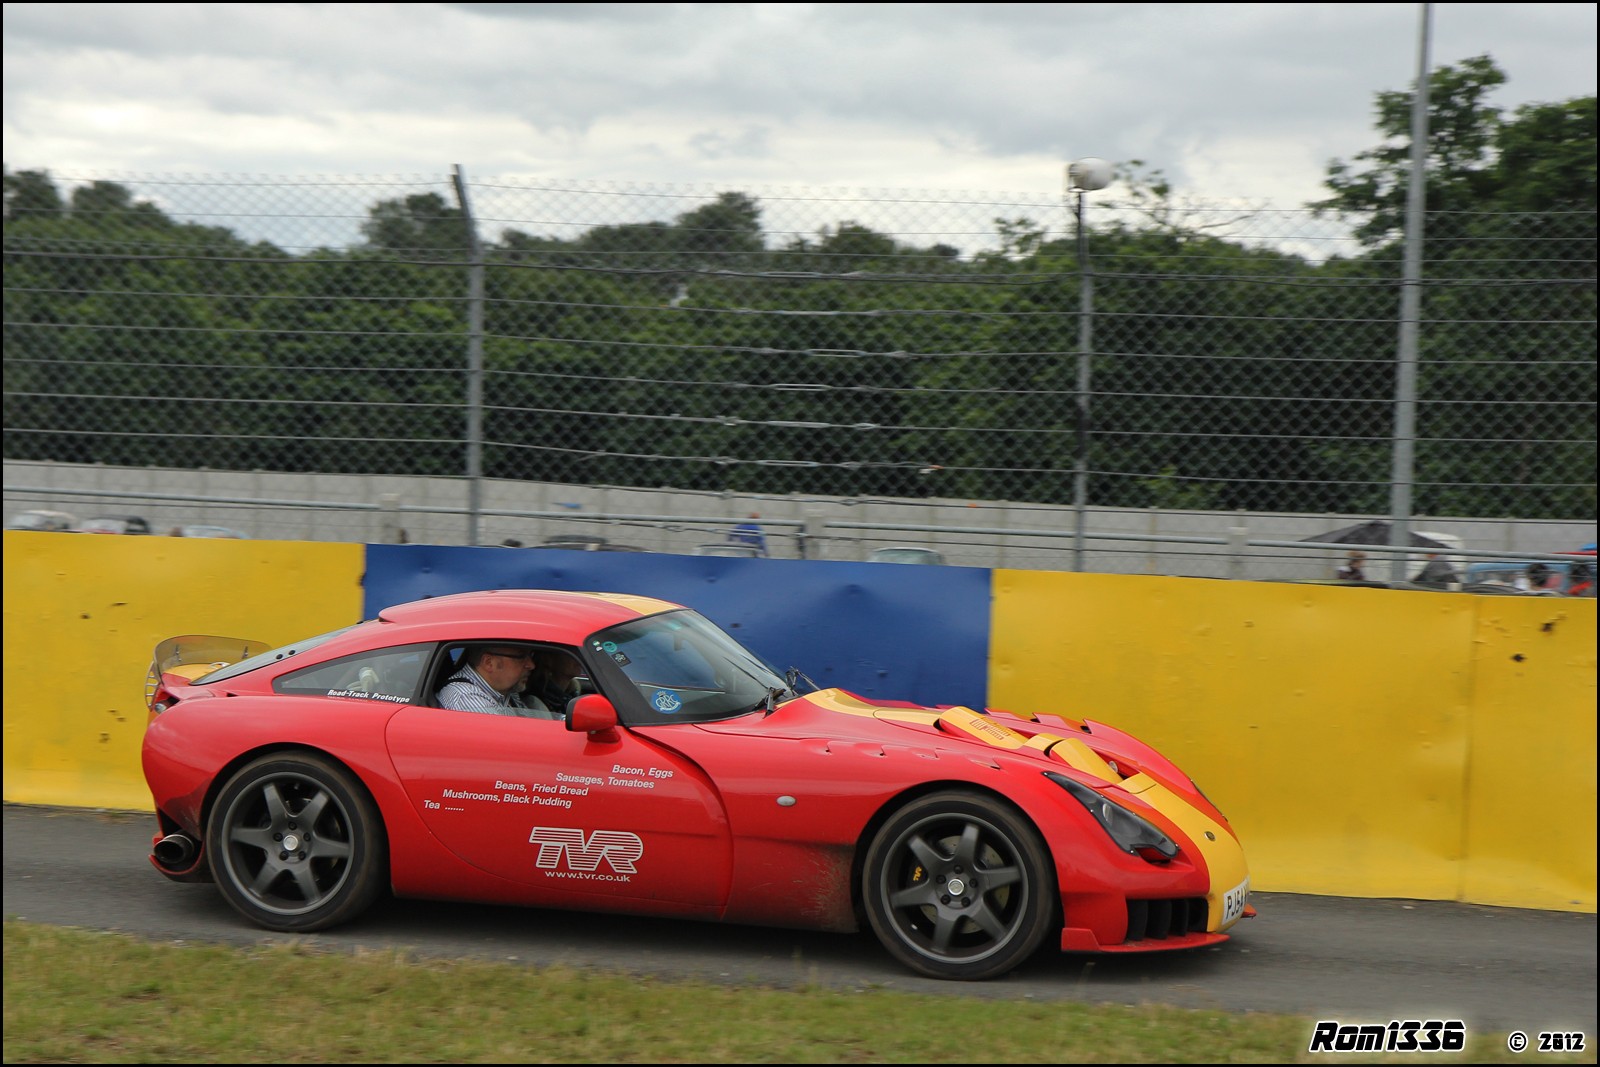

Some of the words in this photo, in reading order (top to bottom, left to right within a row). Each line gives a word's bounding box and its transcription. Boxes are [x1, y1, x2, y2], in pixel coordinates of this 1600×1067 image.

[327, 689, 369, 699] Road-Track
[371, 692, 410, 703] Prototype
[612, 764, 646, 777] Bacon,
[648, 767, 674, 779] Eggs
[495, 780, 527, 793] Beans,
[532, 783, 557, 794] Fried
[559, 785, 589, 796] Bread
[555, 772, 605, 786] Sausages,
[607, 776, 655, 789] Tomatoes
[424, 800, 441, 810] Tea
[443, 788, 501, 803] Mushrooms,
[503, 793, 530, 804] Black
[532, 795, 573, 809] Pudding
[529, 826, 644, 874] TVR
[545, 871, 631, 883] www.tvr.co.uk
